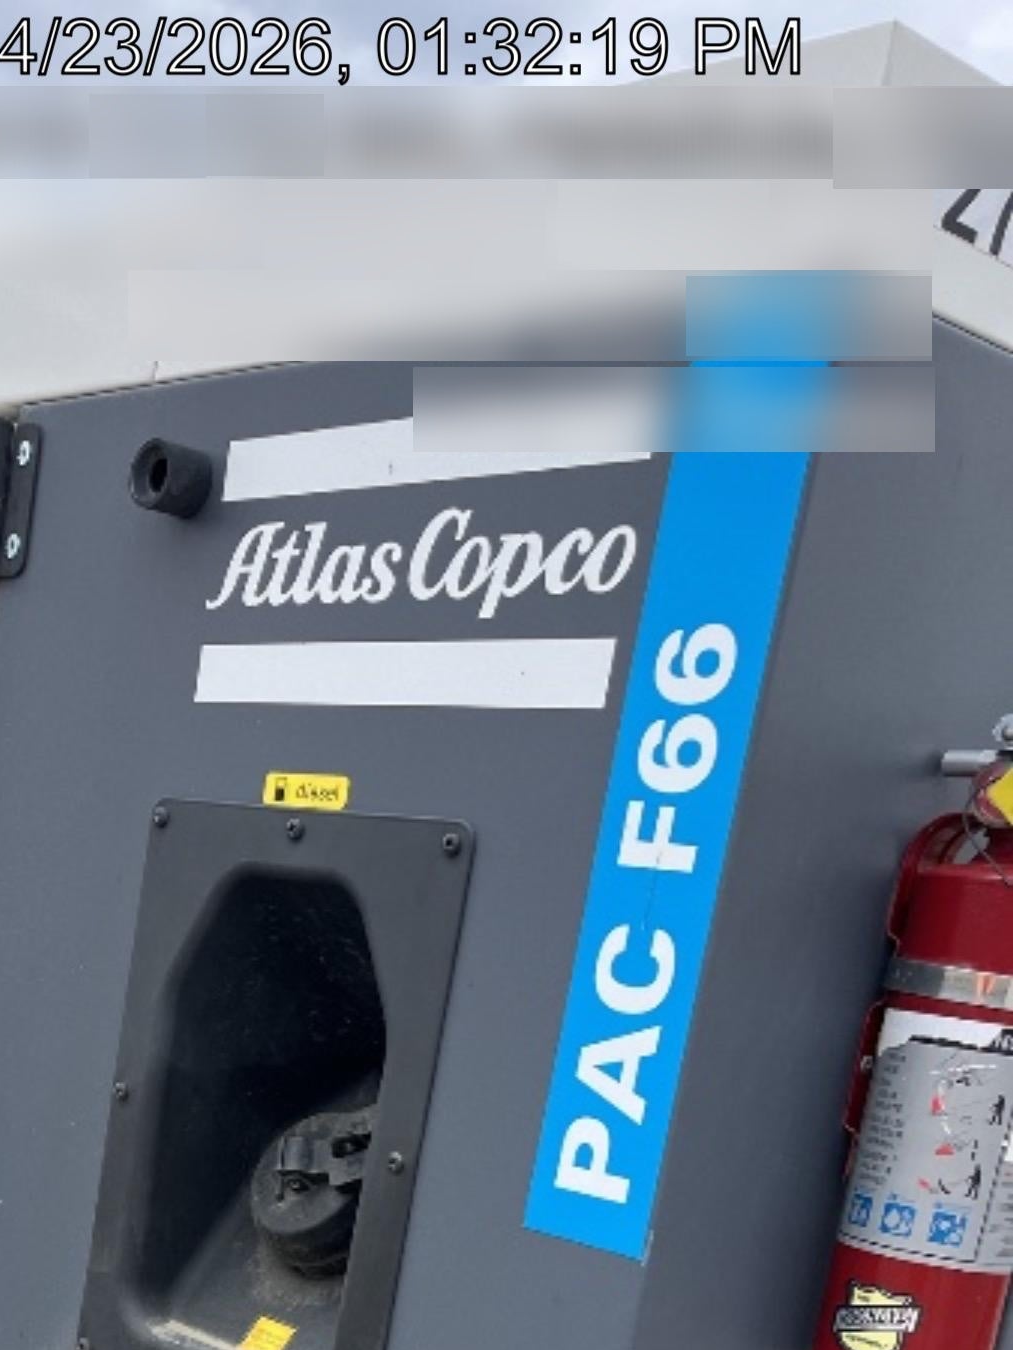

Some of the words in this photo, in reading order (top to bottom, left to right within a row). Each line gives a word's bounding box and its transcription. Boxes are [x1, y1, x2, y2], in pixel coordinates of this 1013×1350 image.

[205, 521, 403, 611] Atlas
[406, 507, 638, 619] Copco
[553, 923, 677, 1204] PAC
[616, 622, 738, 874] F66
